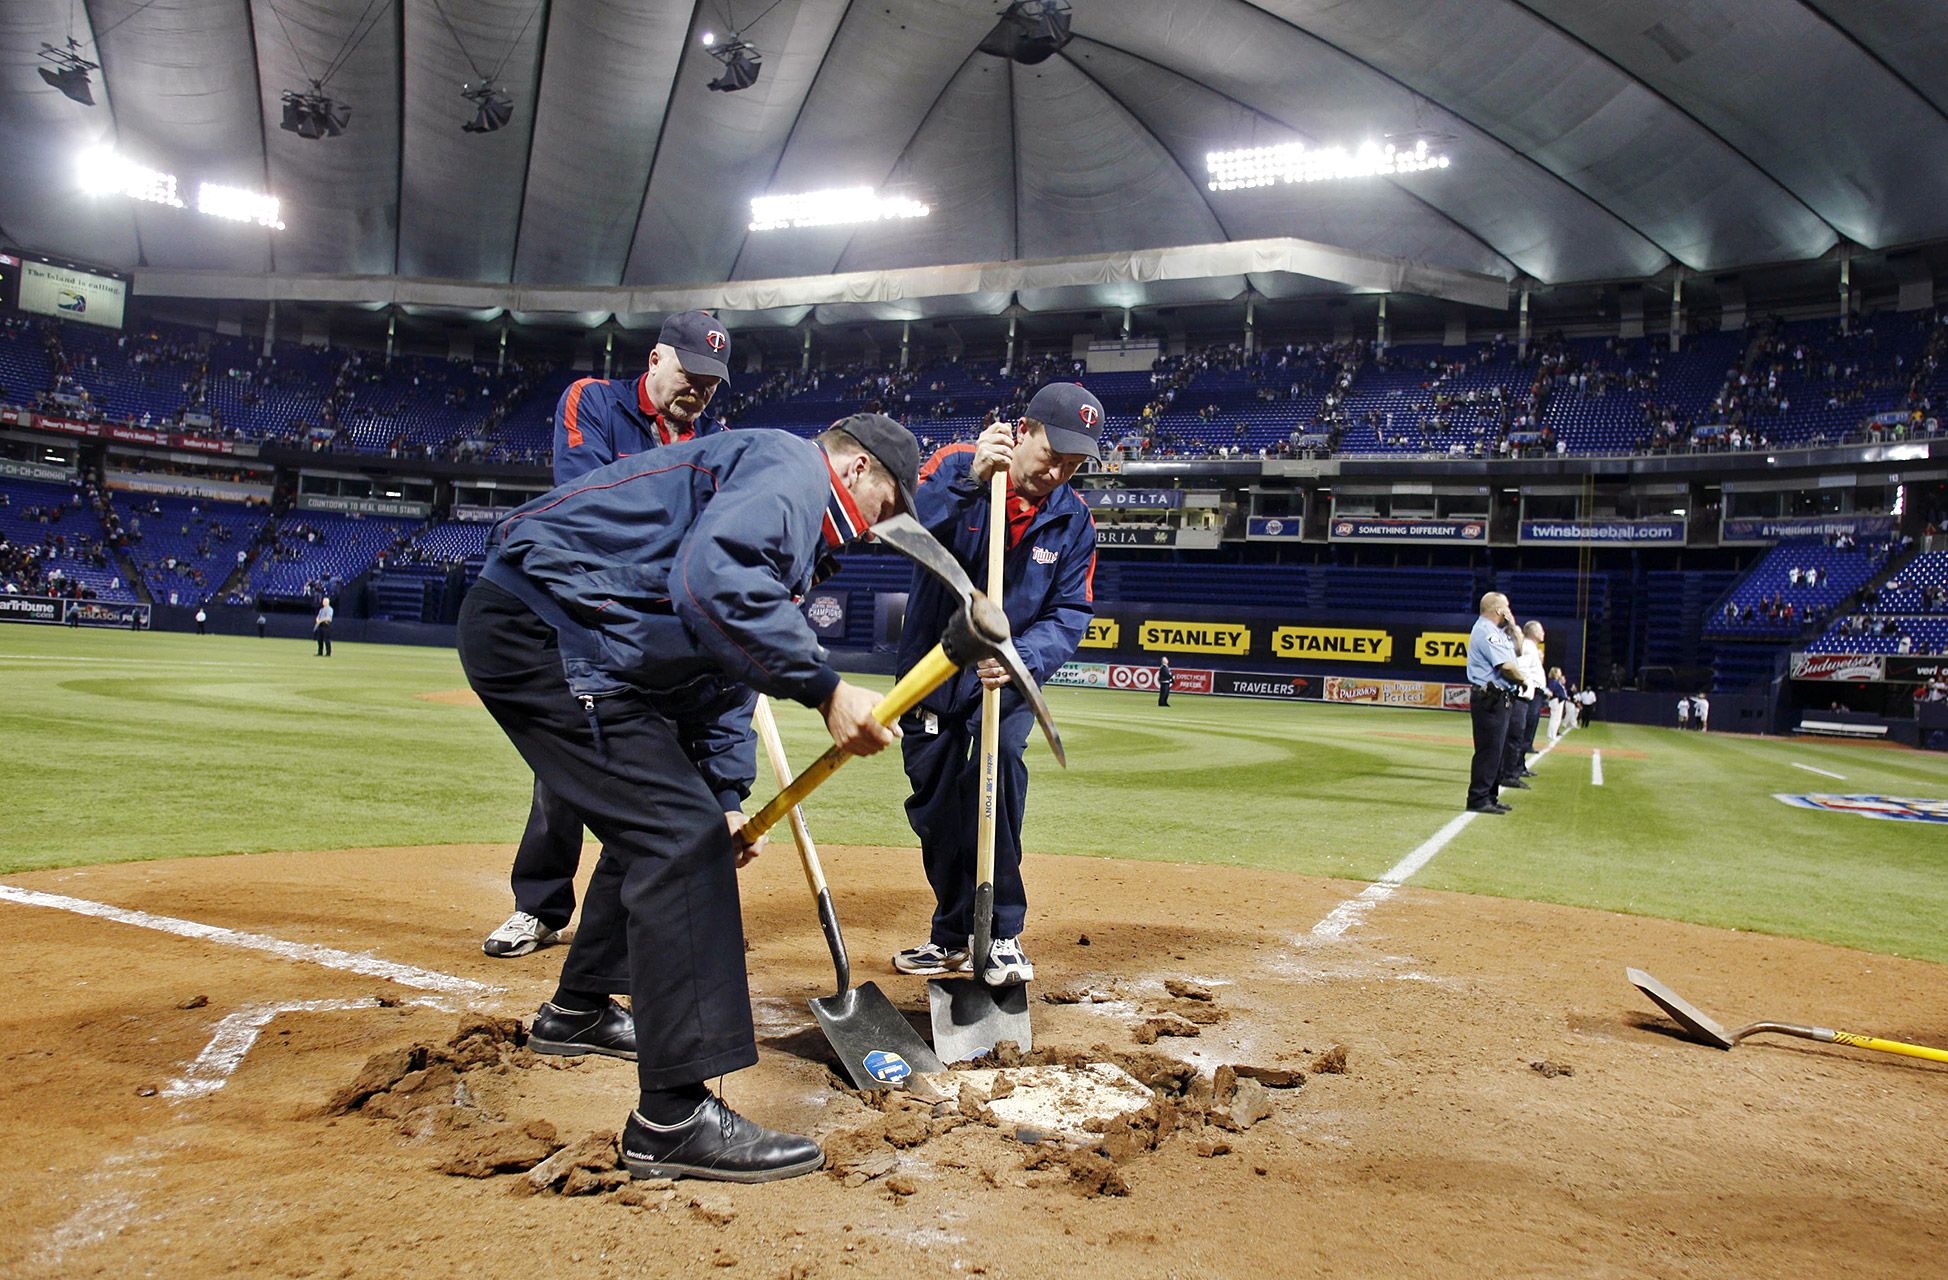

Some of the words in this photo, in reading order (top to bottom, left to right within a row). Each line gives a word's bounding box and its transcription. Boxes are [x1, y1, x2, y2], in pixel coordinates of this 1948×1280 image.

[47, 273, 76, 284] Island
[1116, 494, 1168, 504] DELTA
[308, 499, 348, 509] COUNTDOWN
[350, 502, 358, 510] TO
[377, 503, 398, 513] GRASS
[1358, 525, 1407, 535] SOMETHING
[1409, 526, 1457, 536] DIFFERENT
[1532, 525, 1673, 538] twinsbaseball.com
[1097, 532, 1138, 543] BRIA
[0, 600, 55, 613] arTribune
[808, 607, 843, 618] CHAMPIONS
[1146, 628, 1242, 648] STANLEY
[1280, 633, 1384, 654] STANLEY
[1792, 655, 1876, 678] Budweiser
[1233, 681, 1295, 695] TRAVELERS
[1383, 692, 1425, 702] Perfect
